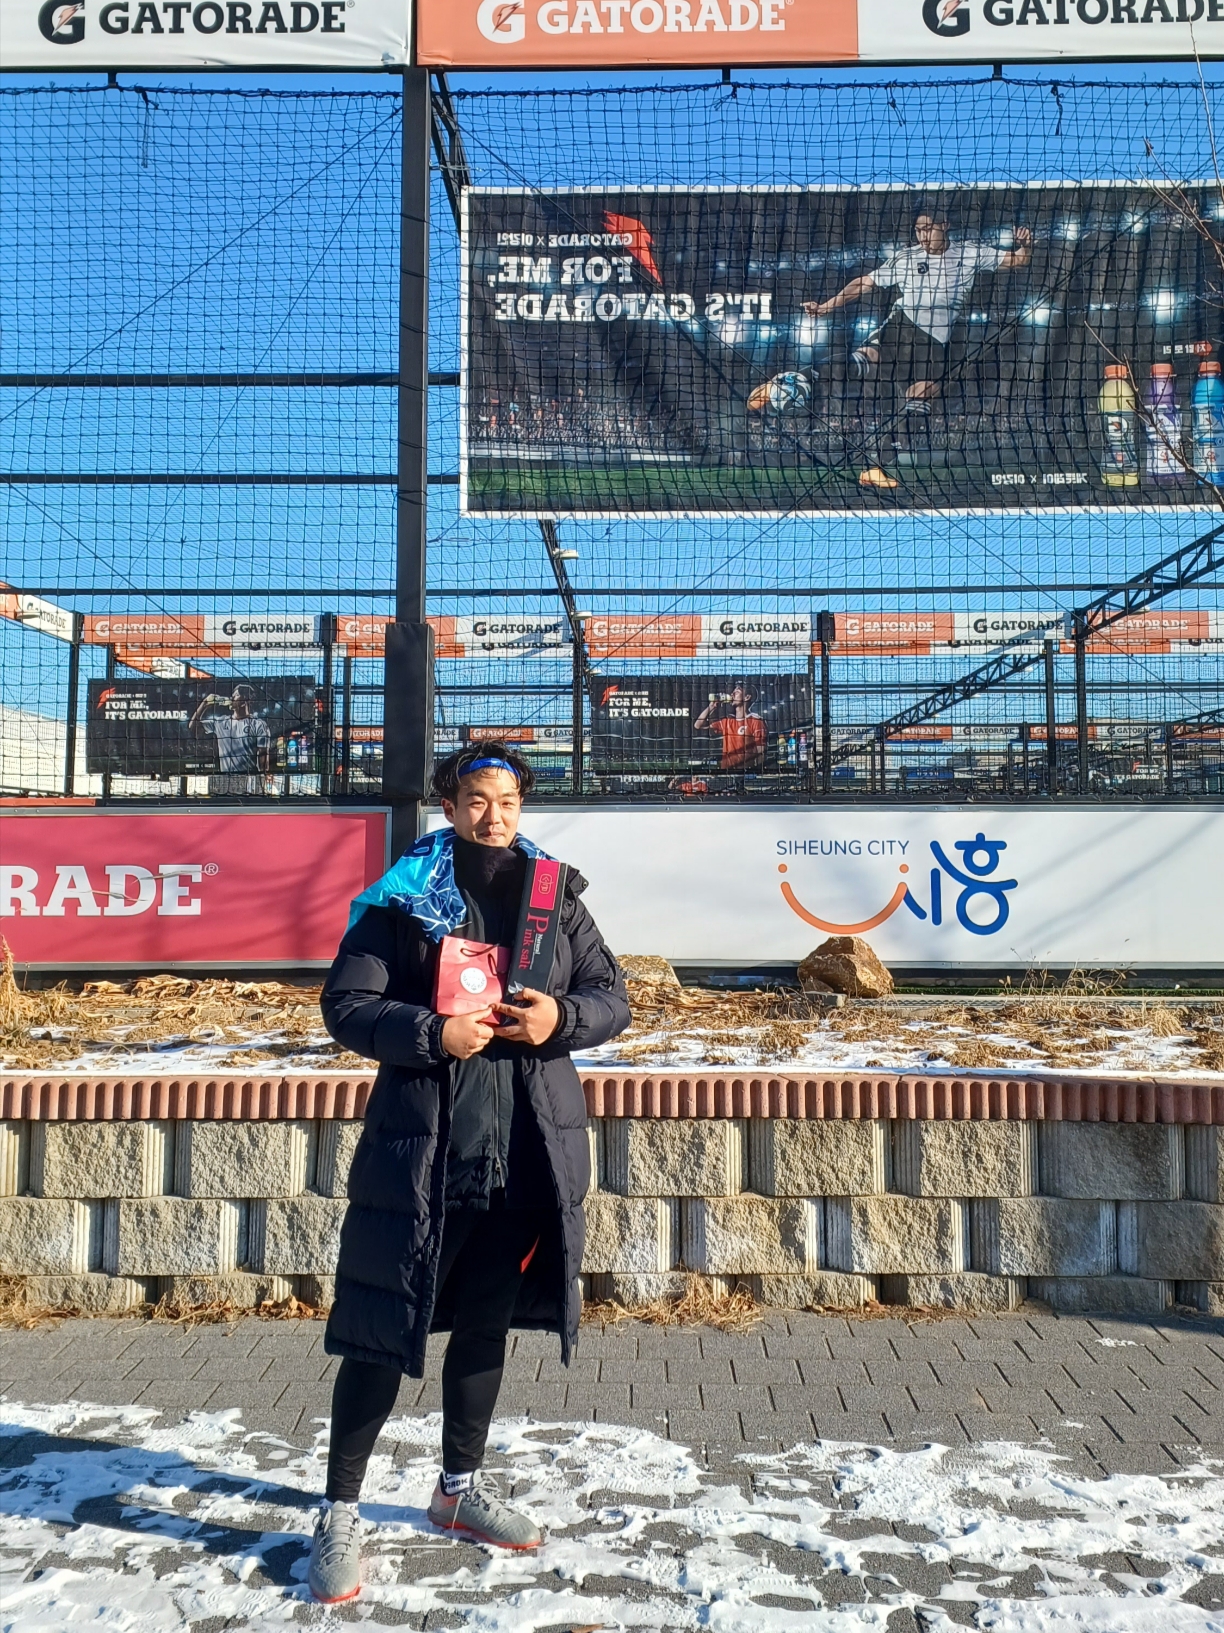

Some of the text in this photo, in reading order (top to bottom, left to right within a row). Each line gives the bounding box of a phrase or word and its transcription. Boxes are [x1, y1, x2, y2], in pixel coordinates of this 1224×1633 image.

[239, 623, 310, 634] GATORADE
[489, 623, 560, 634] GATORADE
[737, 622, 808, 633] GATORADE
[863, 621, 934, 633] GATORADE
[990, 619, 1063, 631] GATORADE
[1115, 619, 1189, 631] GATORADE
[608, 697, 652, 708] FOR ME,
[105, 710, 187, 720] IT'S GATORADE
[608, 707, 689, 717] IT'S GATORADE
[776, 840, 910, 856] SIHEUNG CITY
[518, 947, 531, 970] salt
